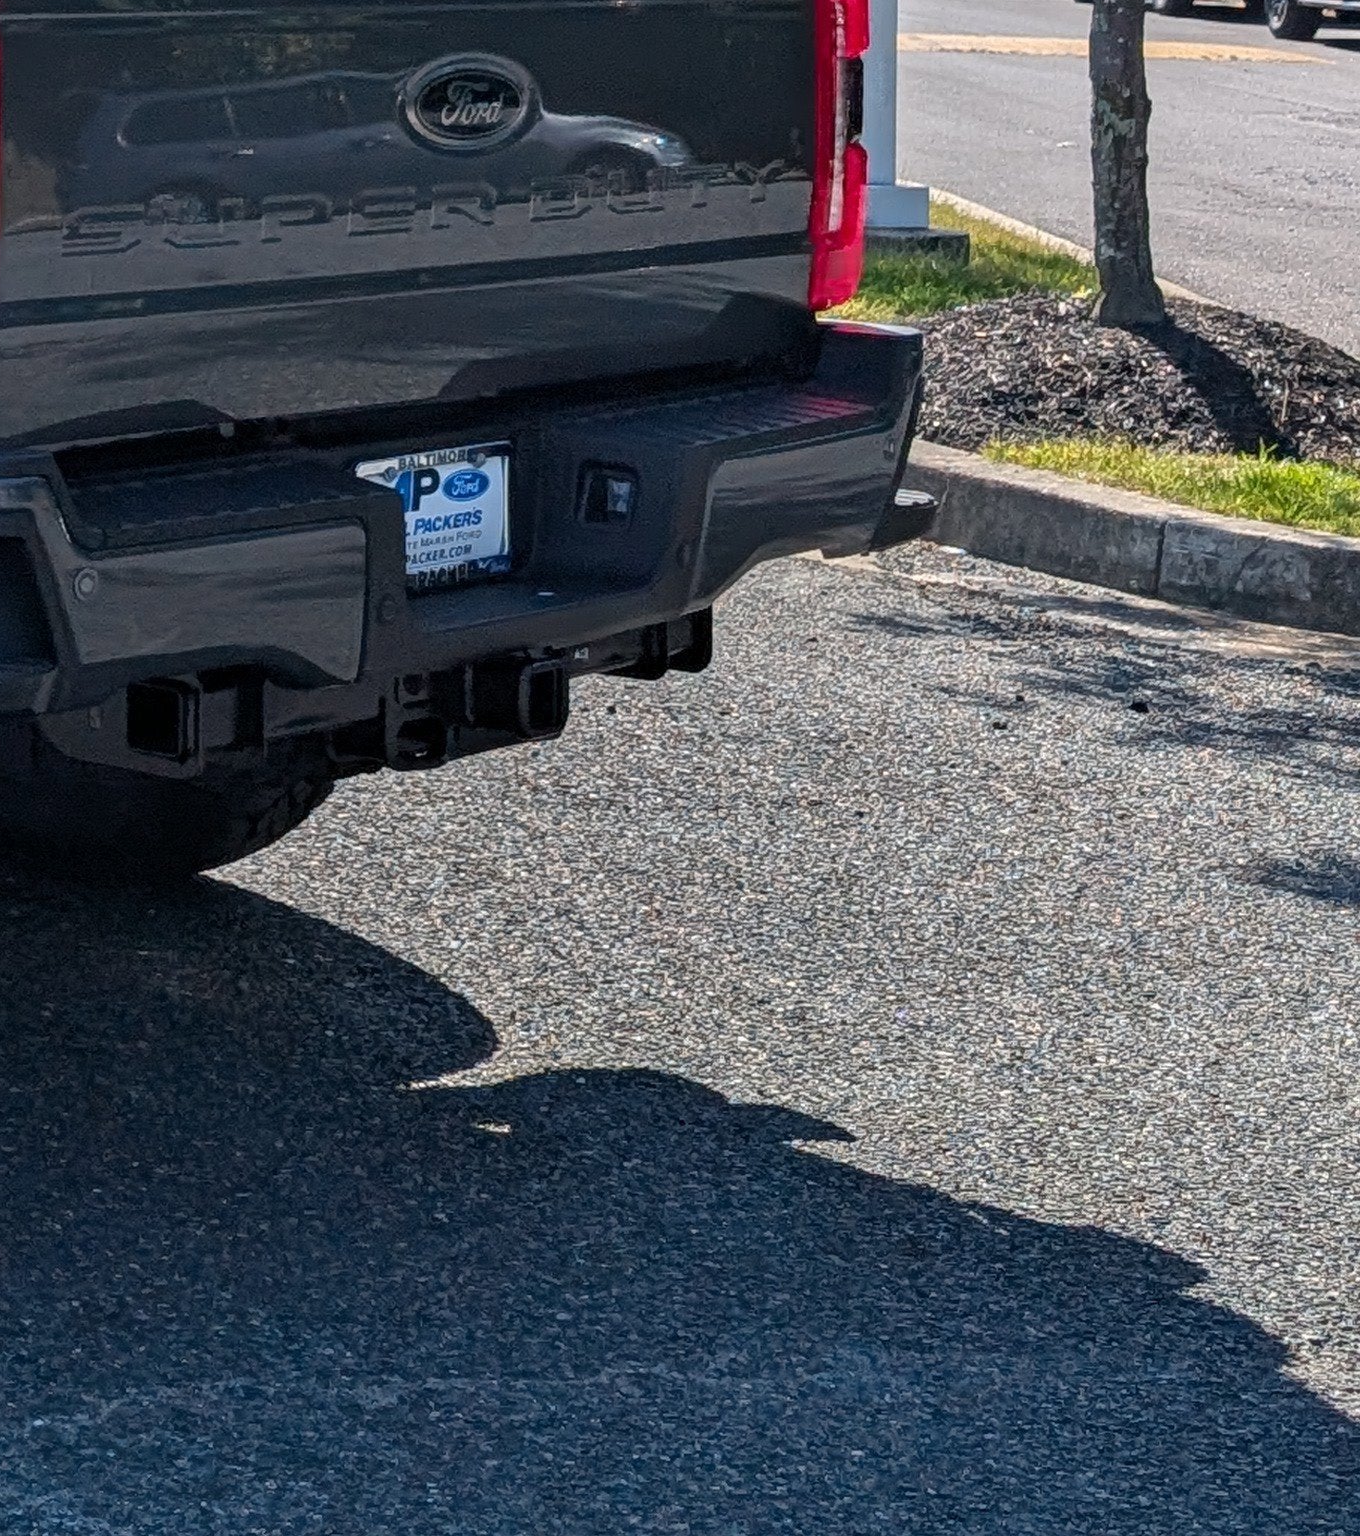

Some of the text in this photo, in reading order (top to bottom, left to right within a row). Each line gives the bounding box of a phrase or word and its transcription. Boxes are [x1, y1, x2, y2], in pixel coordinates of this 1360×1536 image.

[441, 81, 505, 125] Ford
[61, 159, 784, 257] SUPER DUTY
[398, 449, 476, 471] BALTIMOR
[452, 474, 480, 496] Ford
[413, 507, 483, 535] PACKER'S
